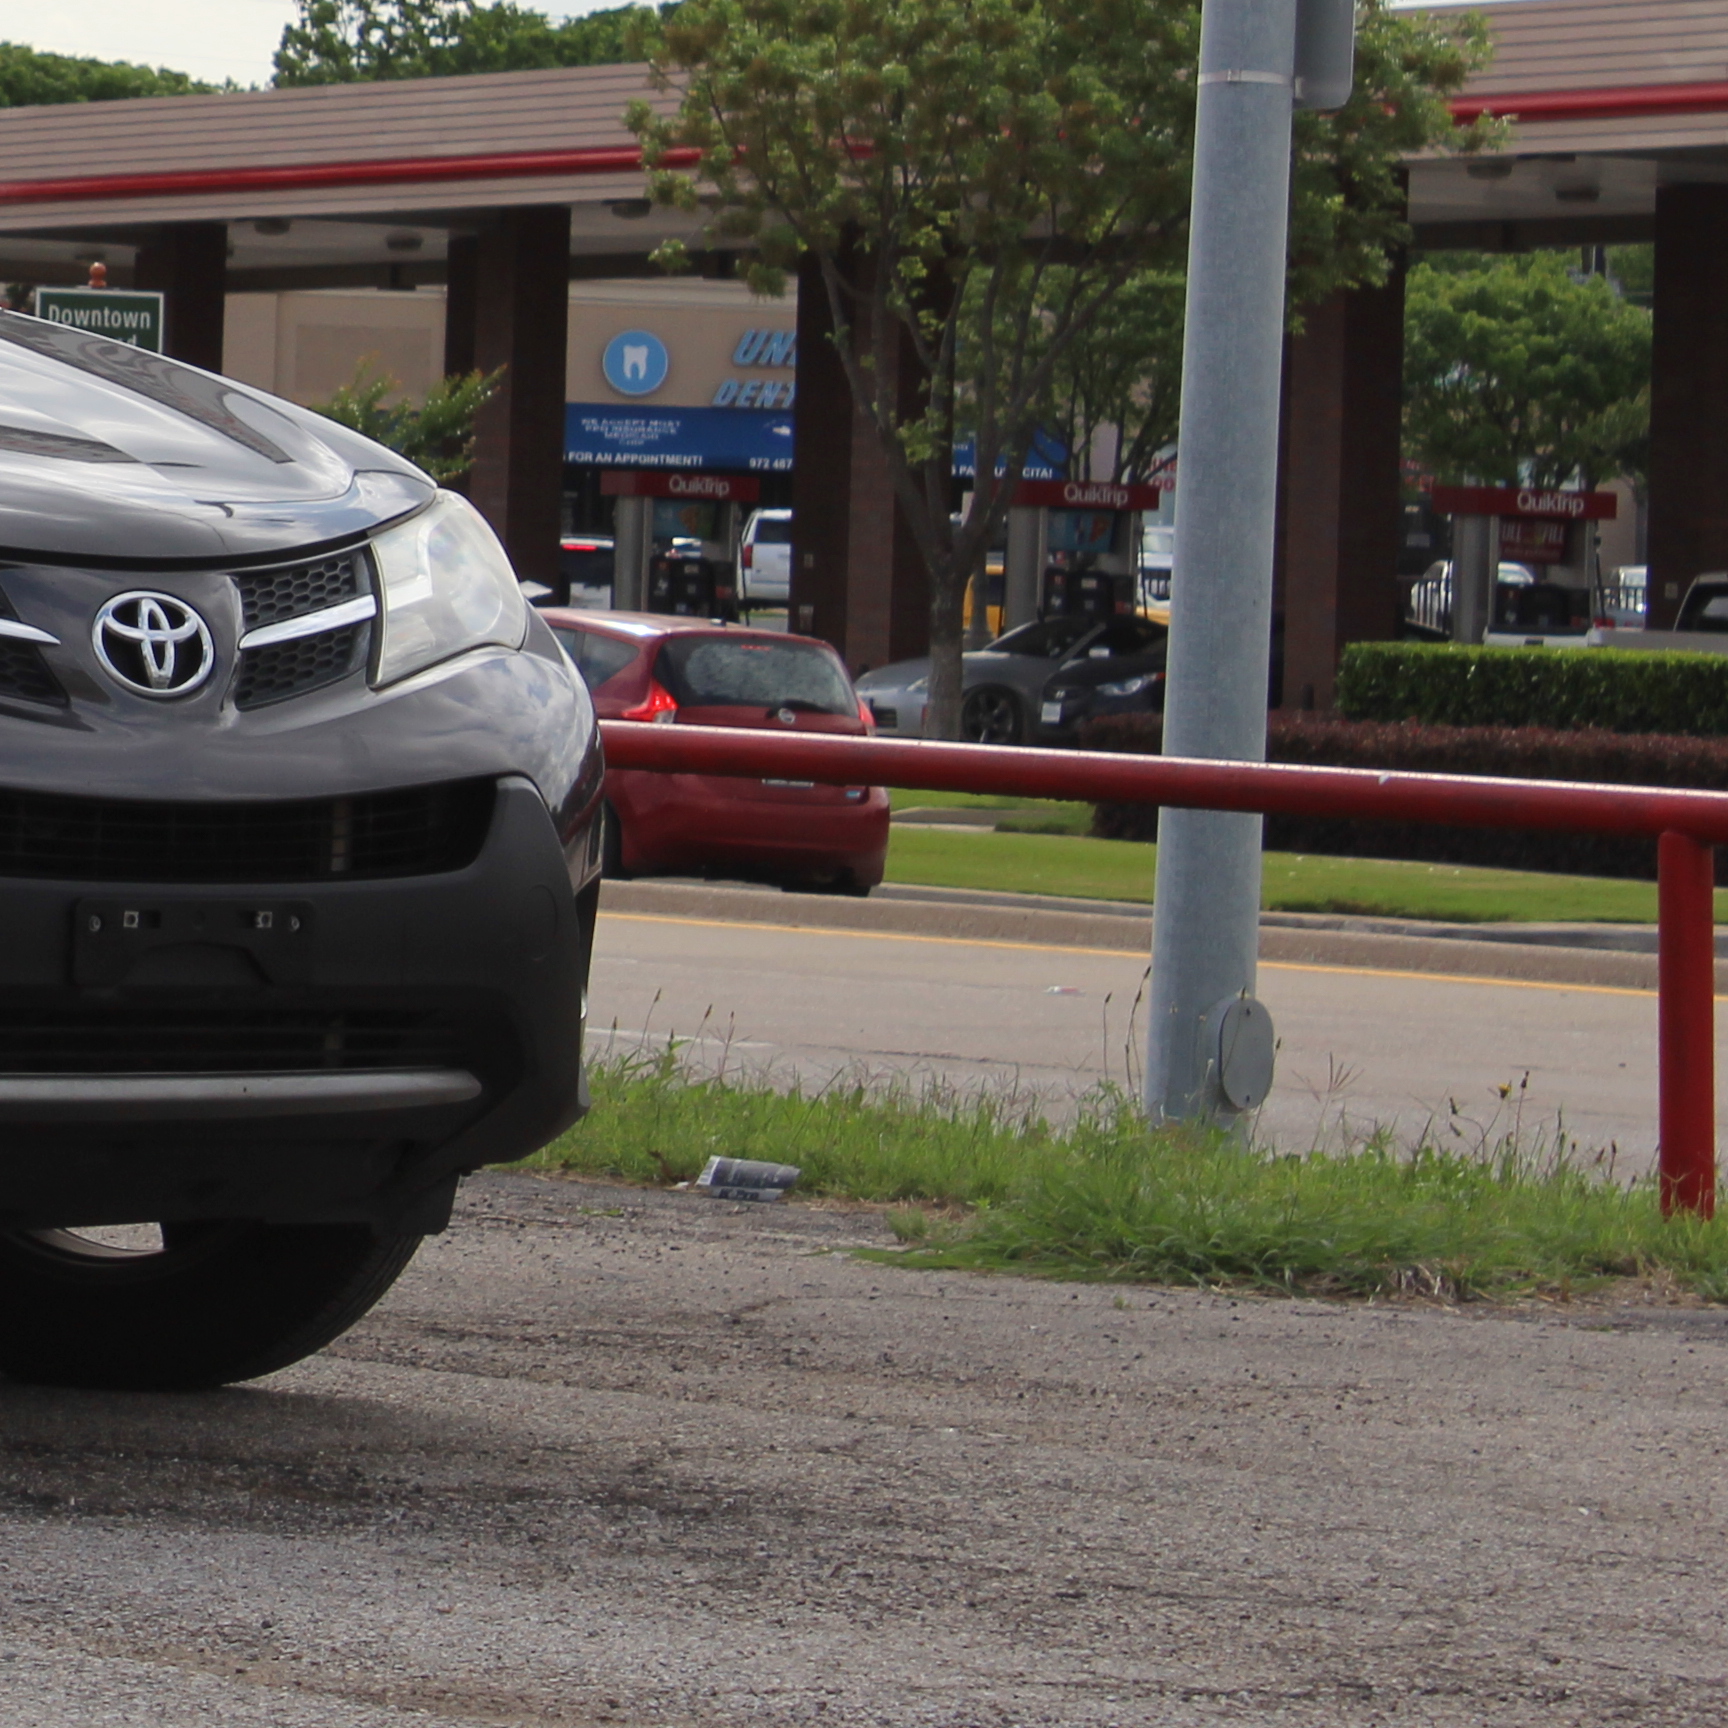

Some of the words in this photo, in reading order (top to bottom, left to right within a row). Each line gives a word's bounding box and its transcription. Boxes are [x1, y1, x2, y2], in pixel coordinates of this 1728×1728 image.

[48, 304, 151, 330] Downtown
[568, 452, 593, 463] FOR
[595, 452, 612, 463] AN
[614, 453, 702, 466] APPOINTMENT!
[669, 475, 730, 497] QuikTrip
[1063, 484, 1128, 507] QuikTrip
[1517, 491, 1585, 516] QuikTrip
